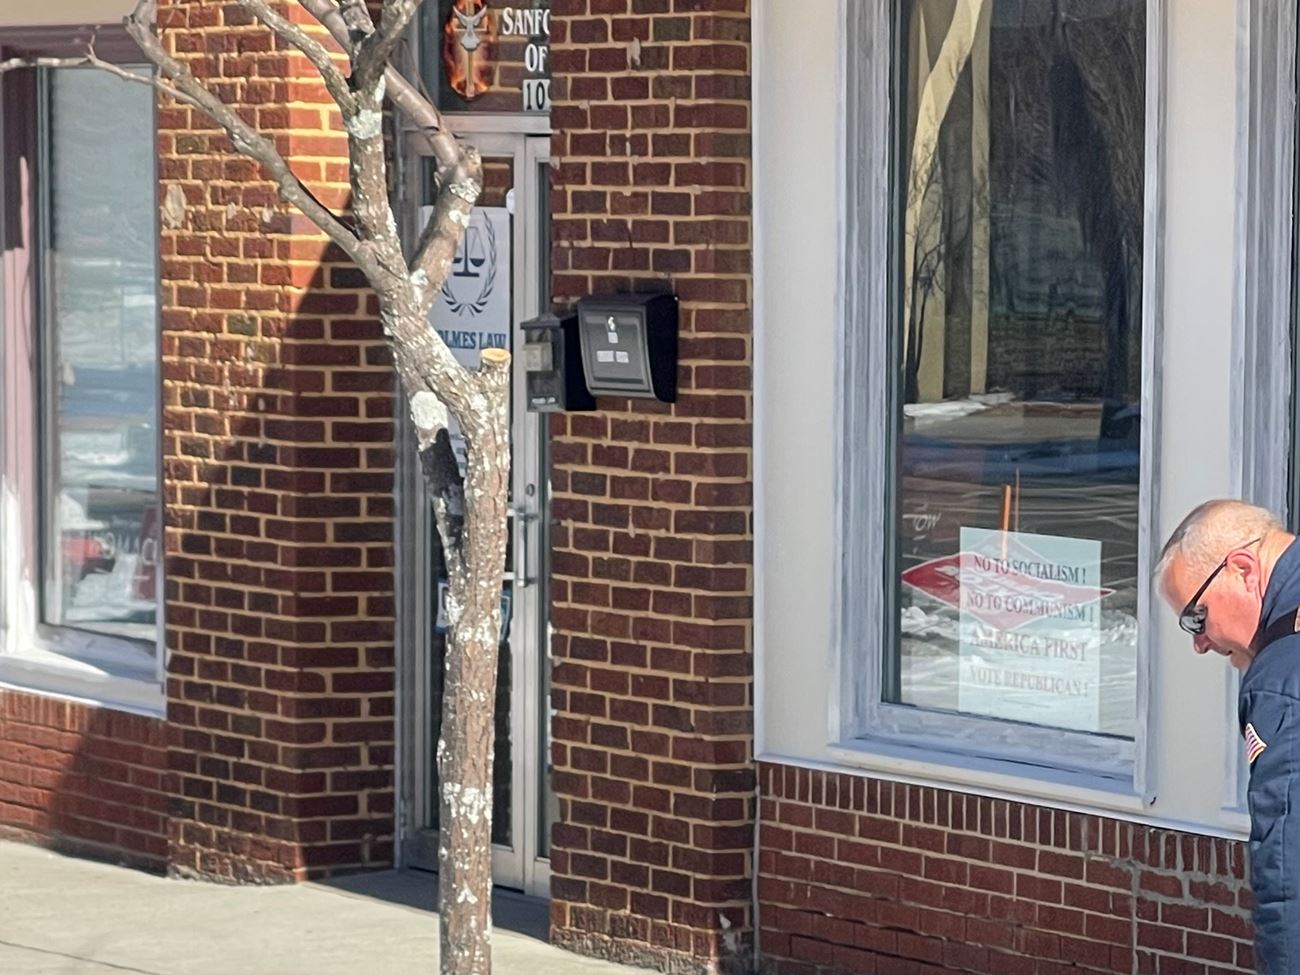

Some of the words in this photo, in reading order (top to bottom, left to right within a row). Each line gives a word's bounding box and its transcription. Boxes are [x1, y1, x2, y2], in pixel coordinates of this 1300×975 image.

[525, 43, 548, 72] OF
[526, 81, 550, 110] 10
[438, 330, 477, 349] LMES
[479, 332, 507, 349] LAW
[975, 556, 991, 571] NO
[994, 558, 1009, 574] TO
[967, 591, 984, 609] NO
[1044, 636, 1088, 662] FIRST
[971, 665, 1000, 685] VOTE
